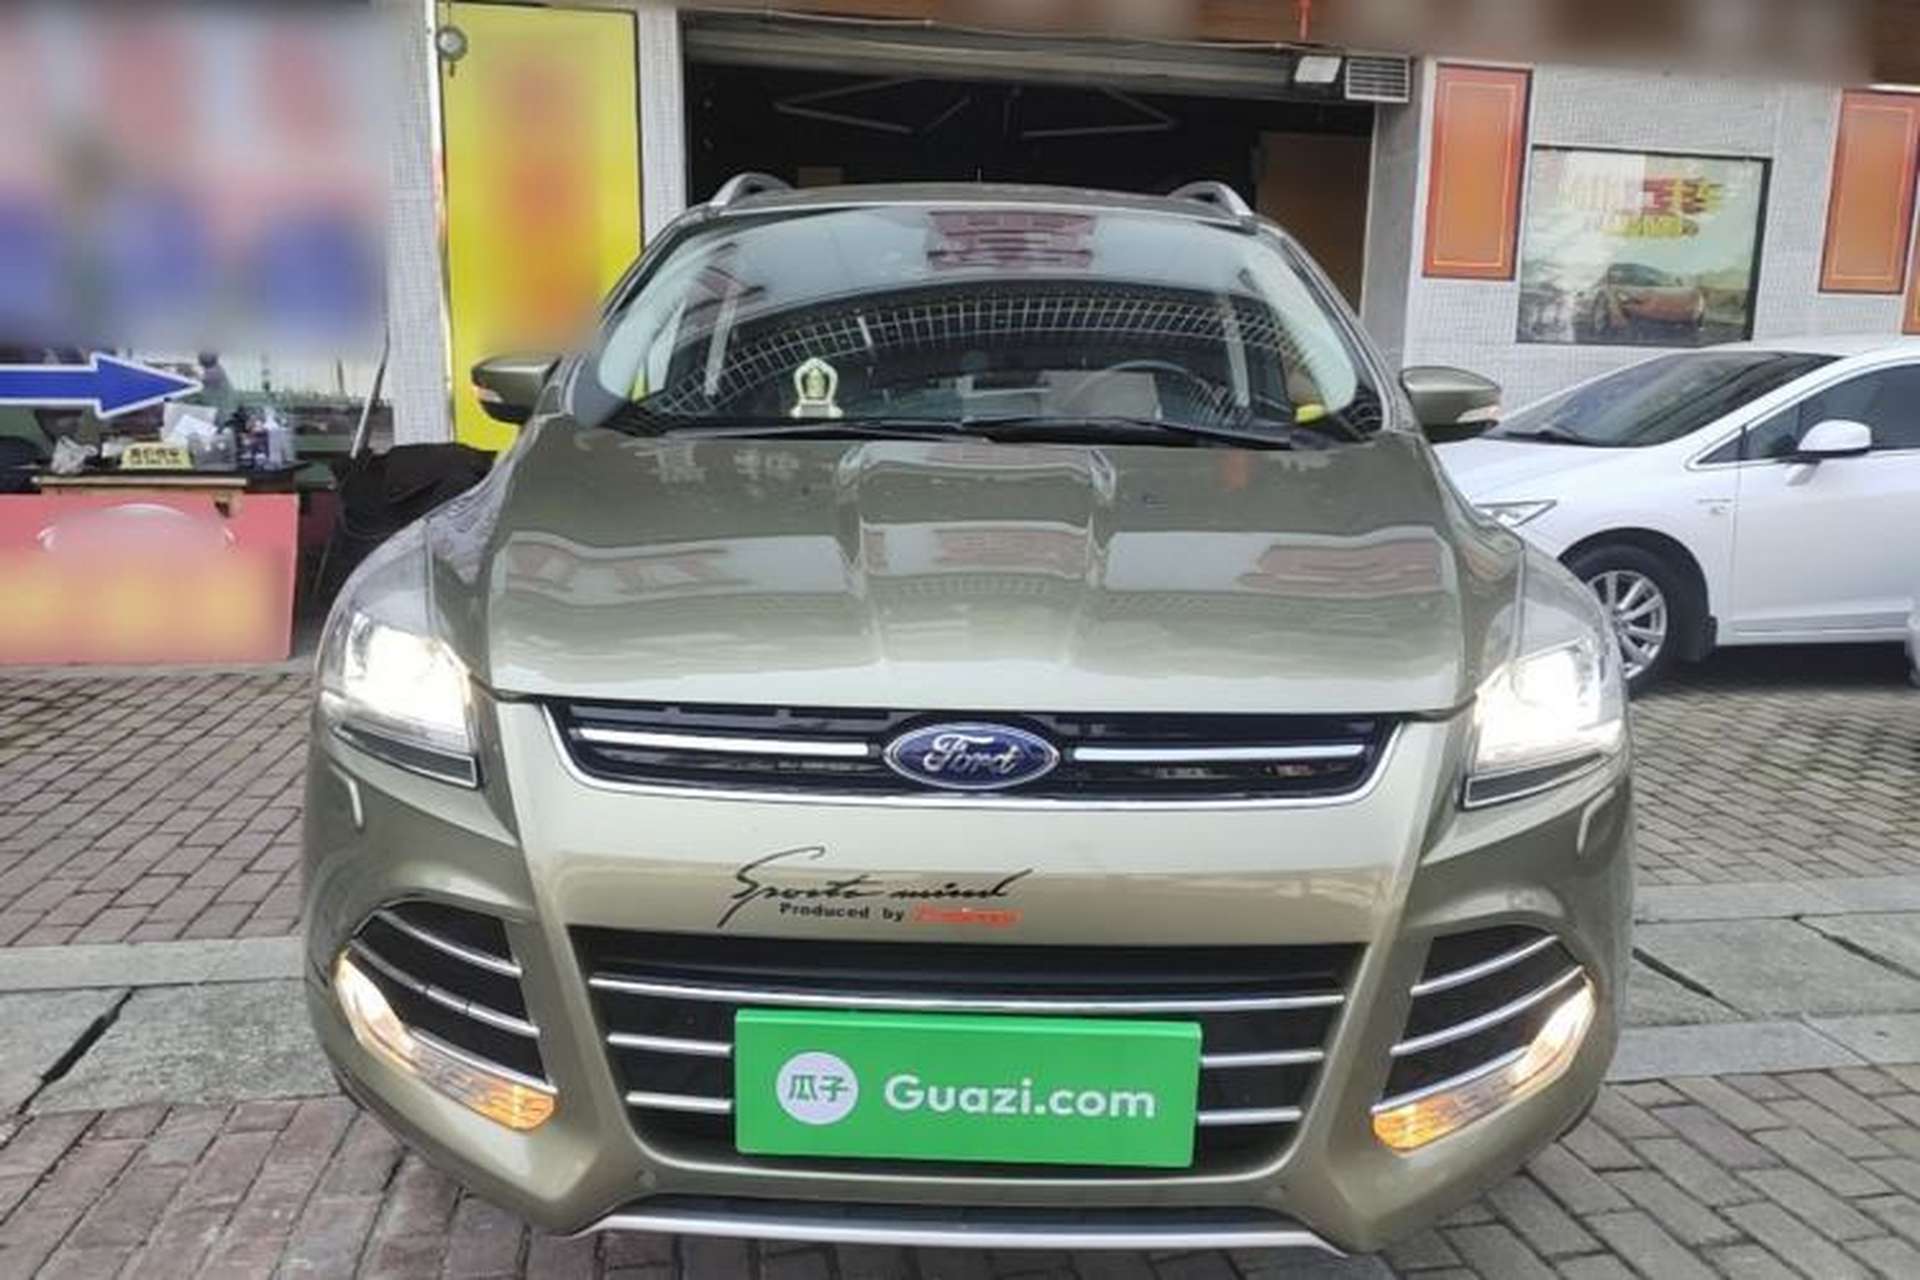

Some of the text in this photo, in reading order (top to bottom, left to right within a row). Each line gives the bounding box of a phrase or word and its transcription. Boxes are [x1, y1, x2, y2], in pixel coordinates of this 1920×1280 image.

[922, 732, 1020, 775] Ford
[779, 901, 870, 920] Produced
[882, 907, 905, 923] by
